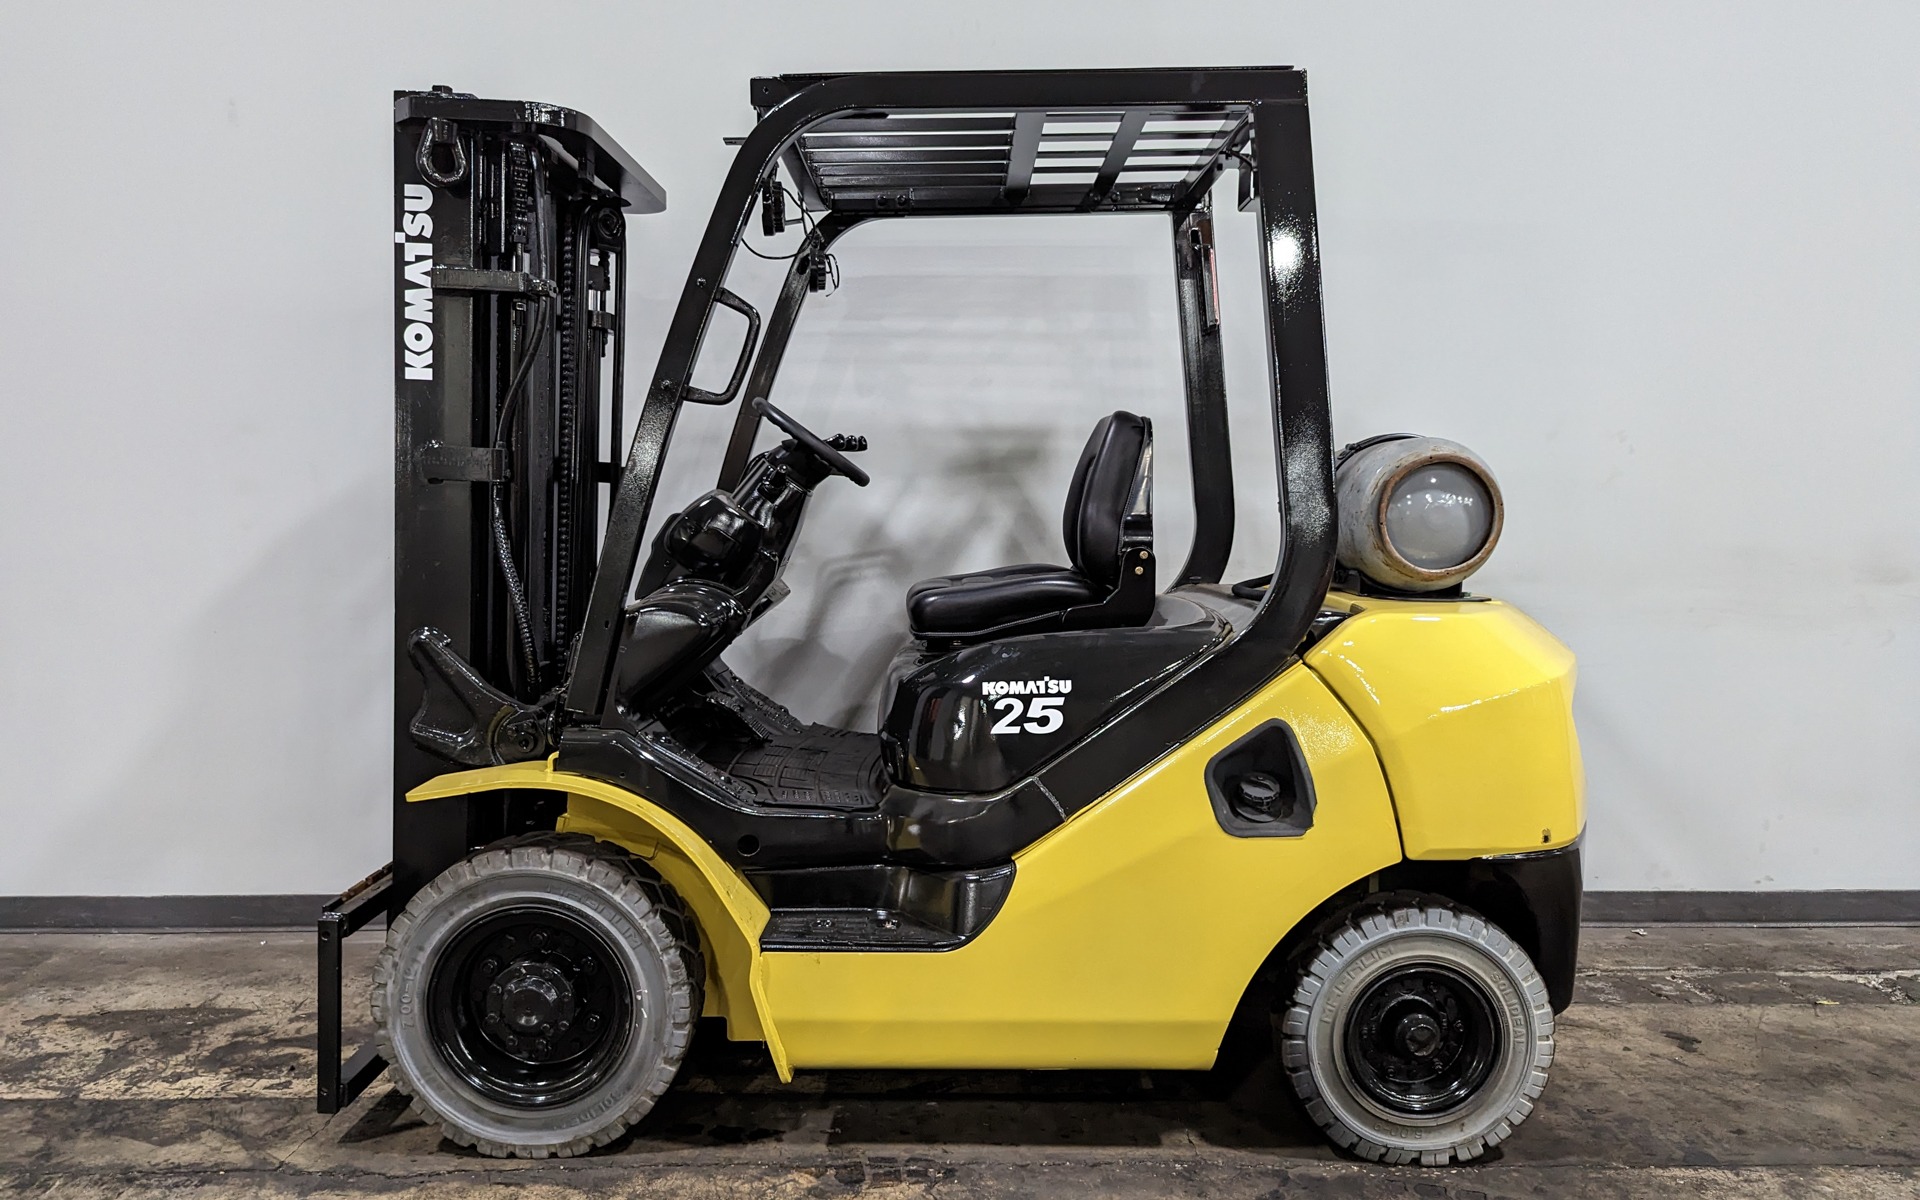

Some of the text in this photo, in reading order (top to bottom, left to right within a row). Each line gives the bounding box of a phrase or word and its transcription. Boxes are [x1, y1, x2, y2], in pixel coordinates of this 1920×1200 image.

[395, 184, 433, 381] KOMATSU
[982, 676, 1072, 695] KOMATSU
[990, 697, 1065, 734] 25
[1490, 972, 1525, 1049] SOLIDEAL
